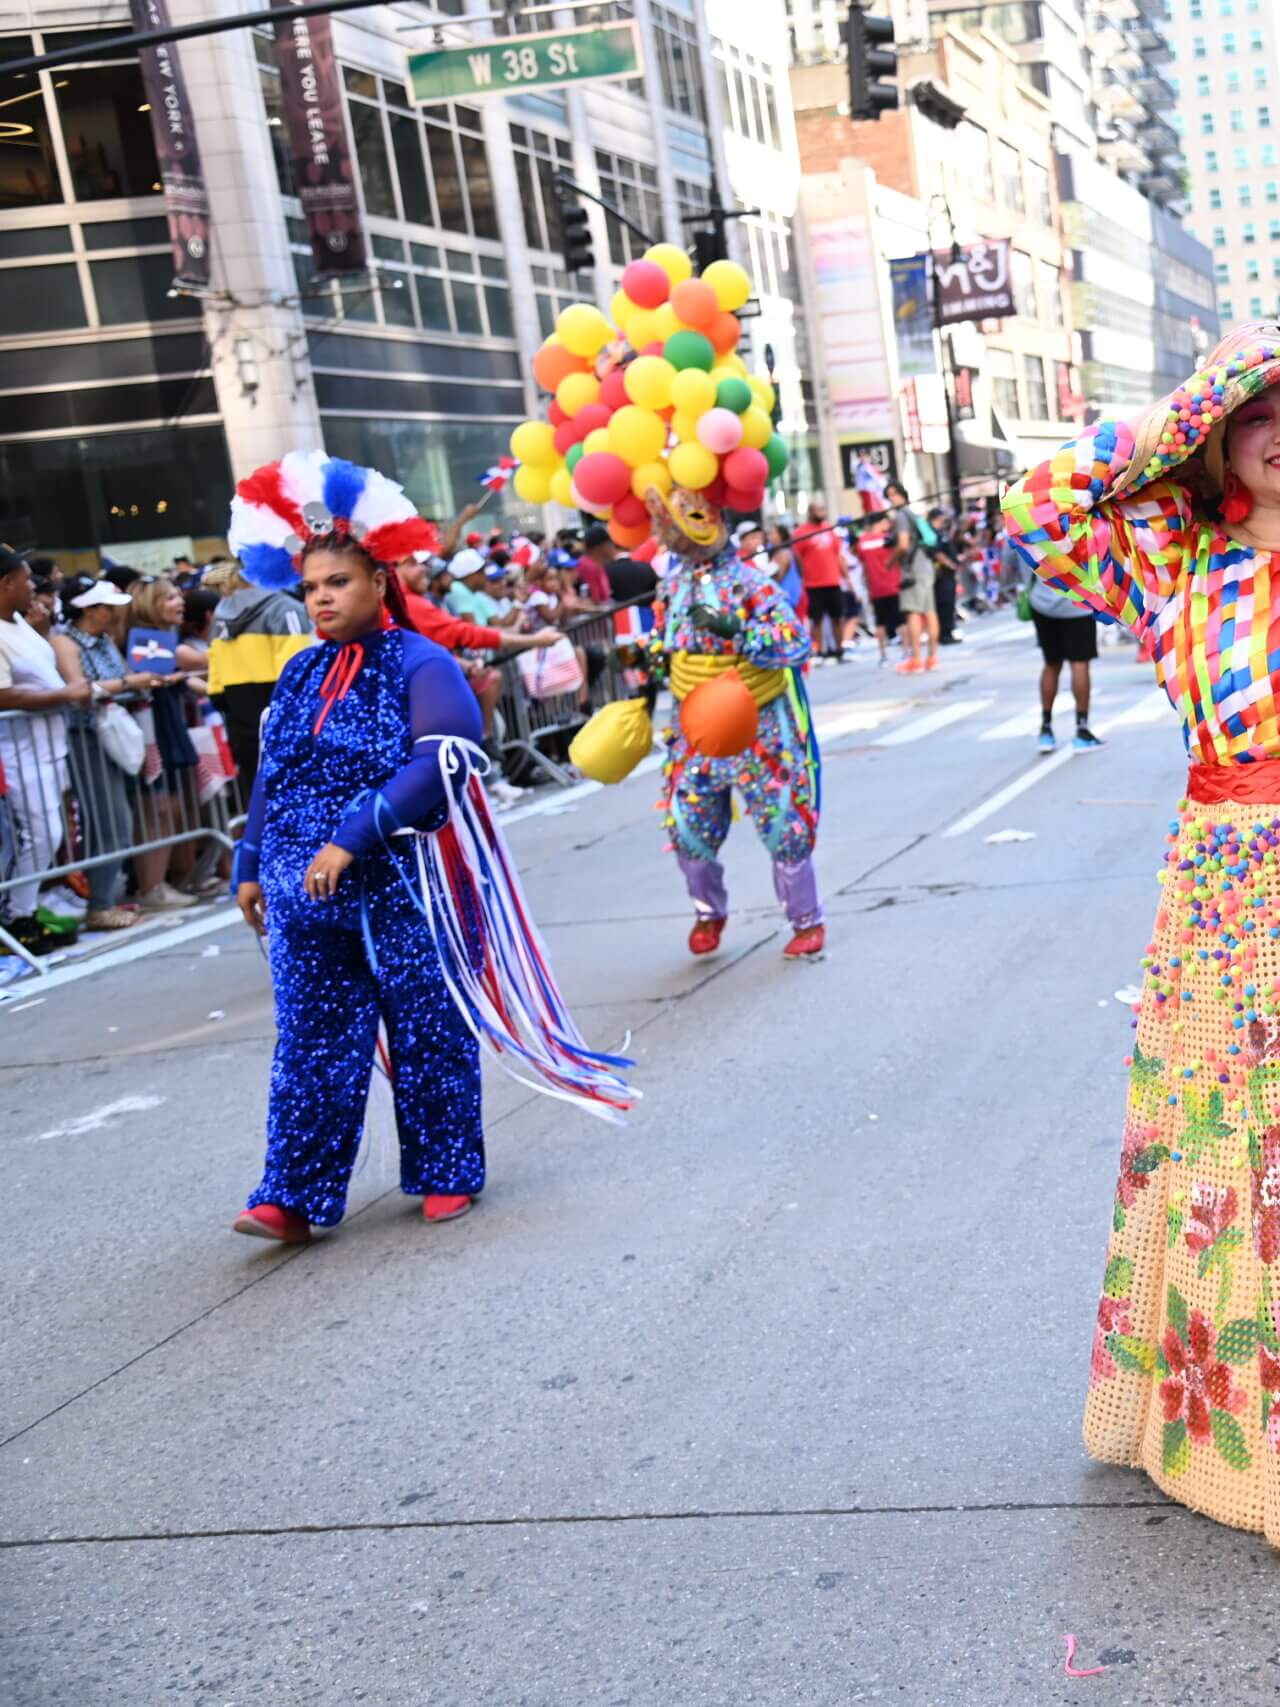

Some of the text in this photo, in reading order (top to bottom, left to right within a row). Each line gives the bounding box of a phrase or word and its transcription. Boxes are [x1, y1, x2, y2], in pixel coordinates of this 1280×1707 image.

[299, 64, 320, 103] YOU
[468, 42, 579, 86] W 38 St
[162, 84, 184, 134] YORK
[305, 108, 330, 165] LEASE
